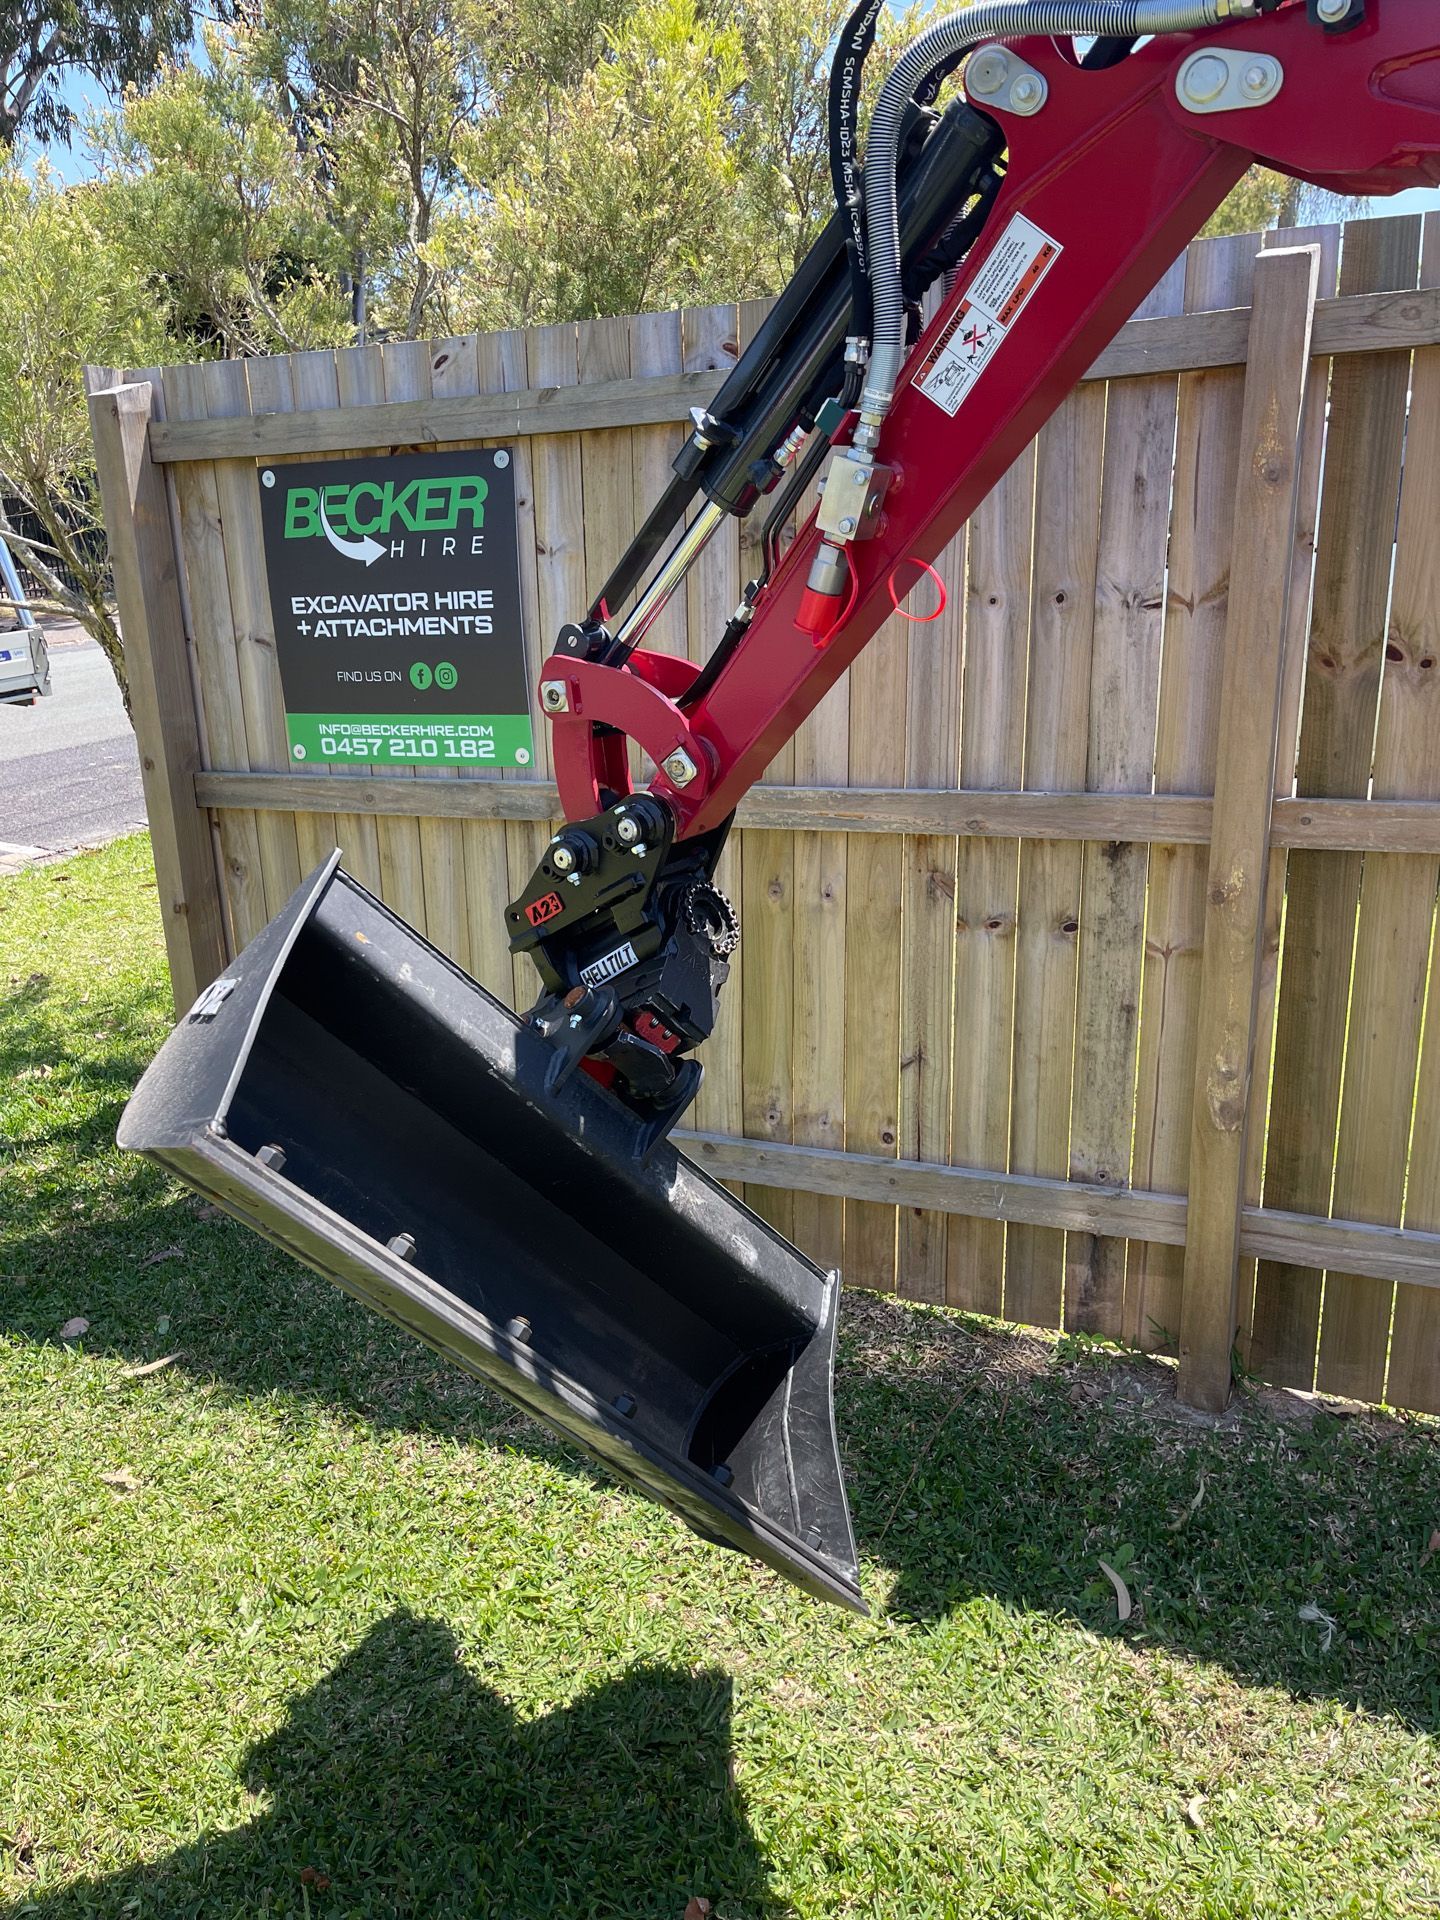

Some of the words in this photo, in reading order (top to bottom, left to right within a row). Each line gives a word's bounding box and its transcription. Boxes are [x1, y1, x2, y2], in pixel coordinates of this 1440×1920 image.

[851, 0, 881, 50] AIPAN
[839, 56, 856, 157] SCMSHA-ID23
[841, 161, 857, 206] MSHA
[1000, 305, 1012, 322] MAX
[926, 307, 965, 365] WARNING
[284, 475, 489, 539] BECKER
[390, 535, 485, 558] HIRE
[291, 592, 429, 614] EXCAVATOR
[434, 590, 494, 611] HIRE
[336, 671, 362, 682] FIND
[365, 671, 381, 682] US
[384, 671, 402, 682] ON
[319, 724, 494, 737] INFO@BECKERHIRE.COM
[321, 737, 383, 756] 0457
[389, 738, 438, 757] 210
[443, 739, 496, 758] 182
